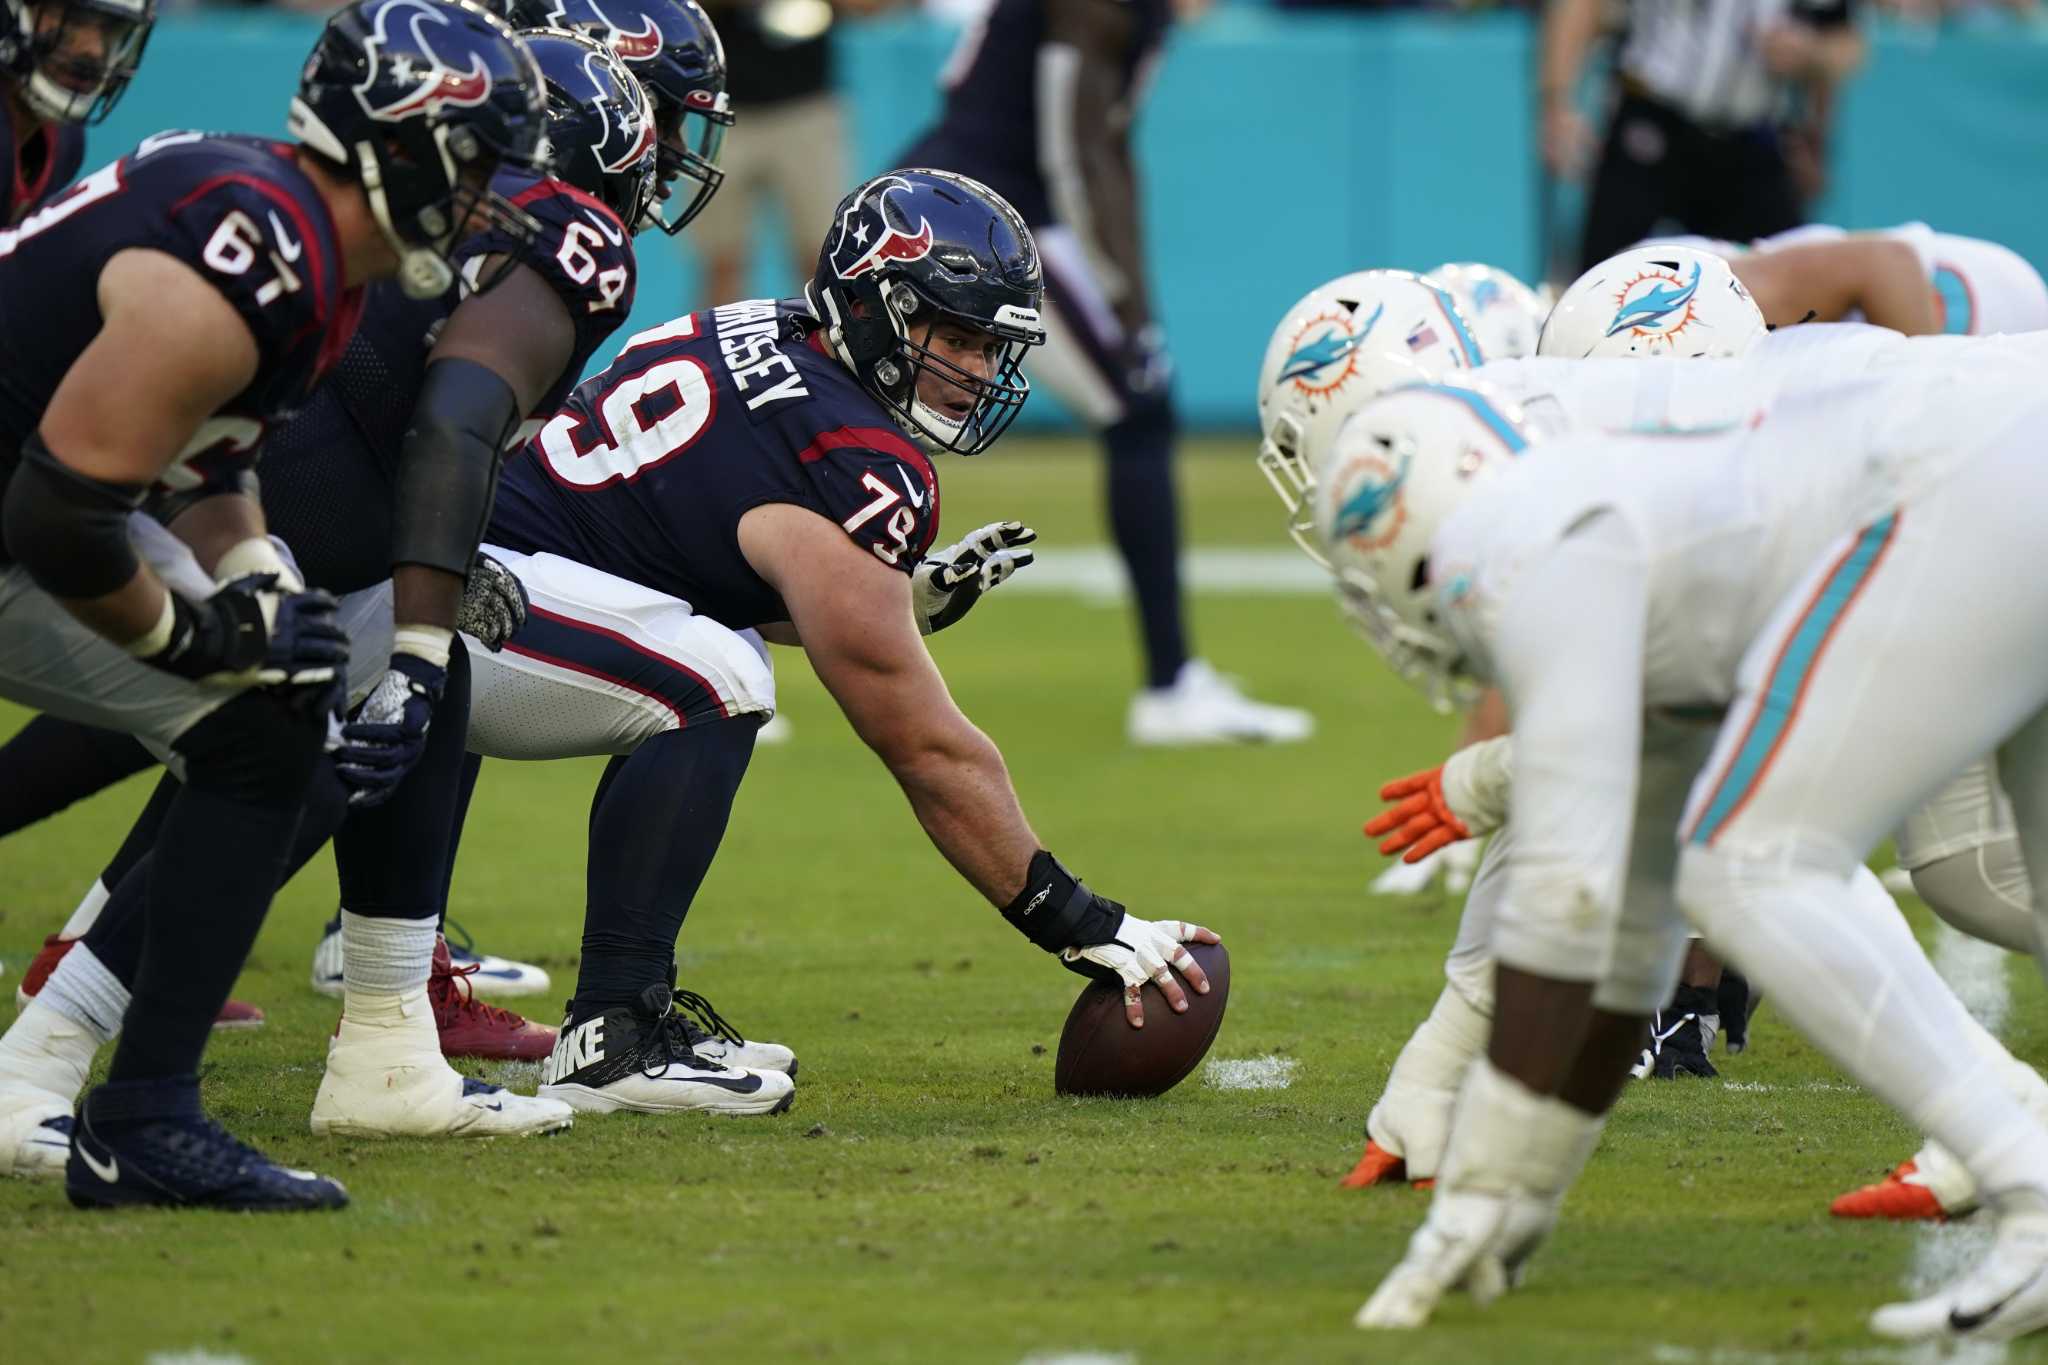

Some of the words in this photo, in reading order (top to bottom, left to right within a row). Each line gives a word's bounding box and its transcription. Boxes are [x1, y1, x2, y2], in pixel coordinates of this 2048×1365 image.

[202, 209, 302, 307] 67
[555, 220, 628, 313] 64
[841, 471, 916, 565] 79
